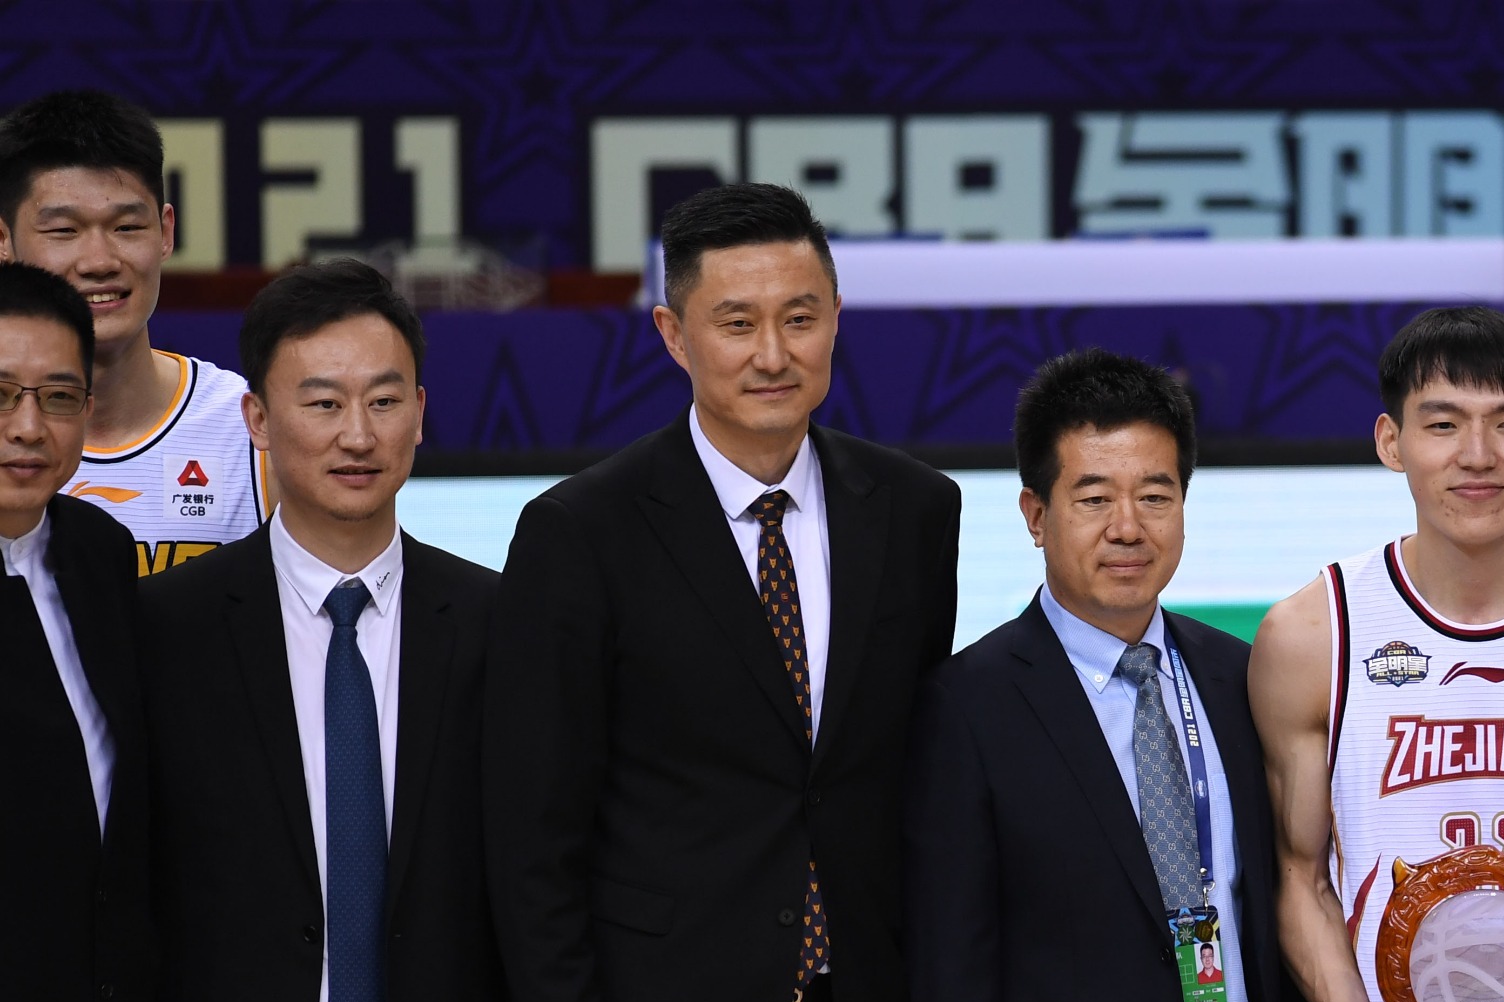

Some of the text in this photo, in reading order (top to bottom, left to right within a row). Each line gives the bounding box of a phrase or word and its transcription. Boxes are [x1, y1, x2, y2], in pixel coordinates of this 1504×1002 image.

[163, 117, 461, 275] 021
[172, 494, 214, 504] 广发银行
[180, 506, 206, 516] CGB
[1368, 655, 1428, 676] 全明星
[1186, 723, 1200, 747] 2021
